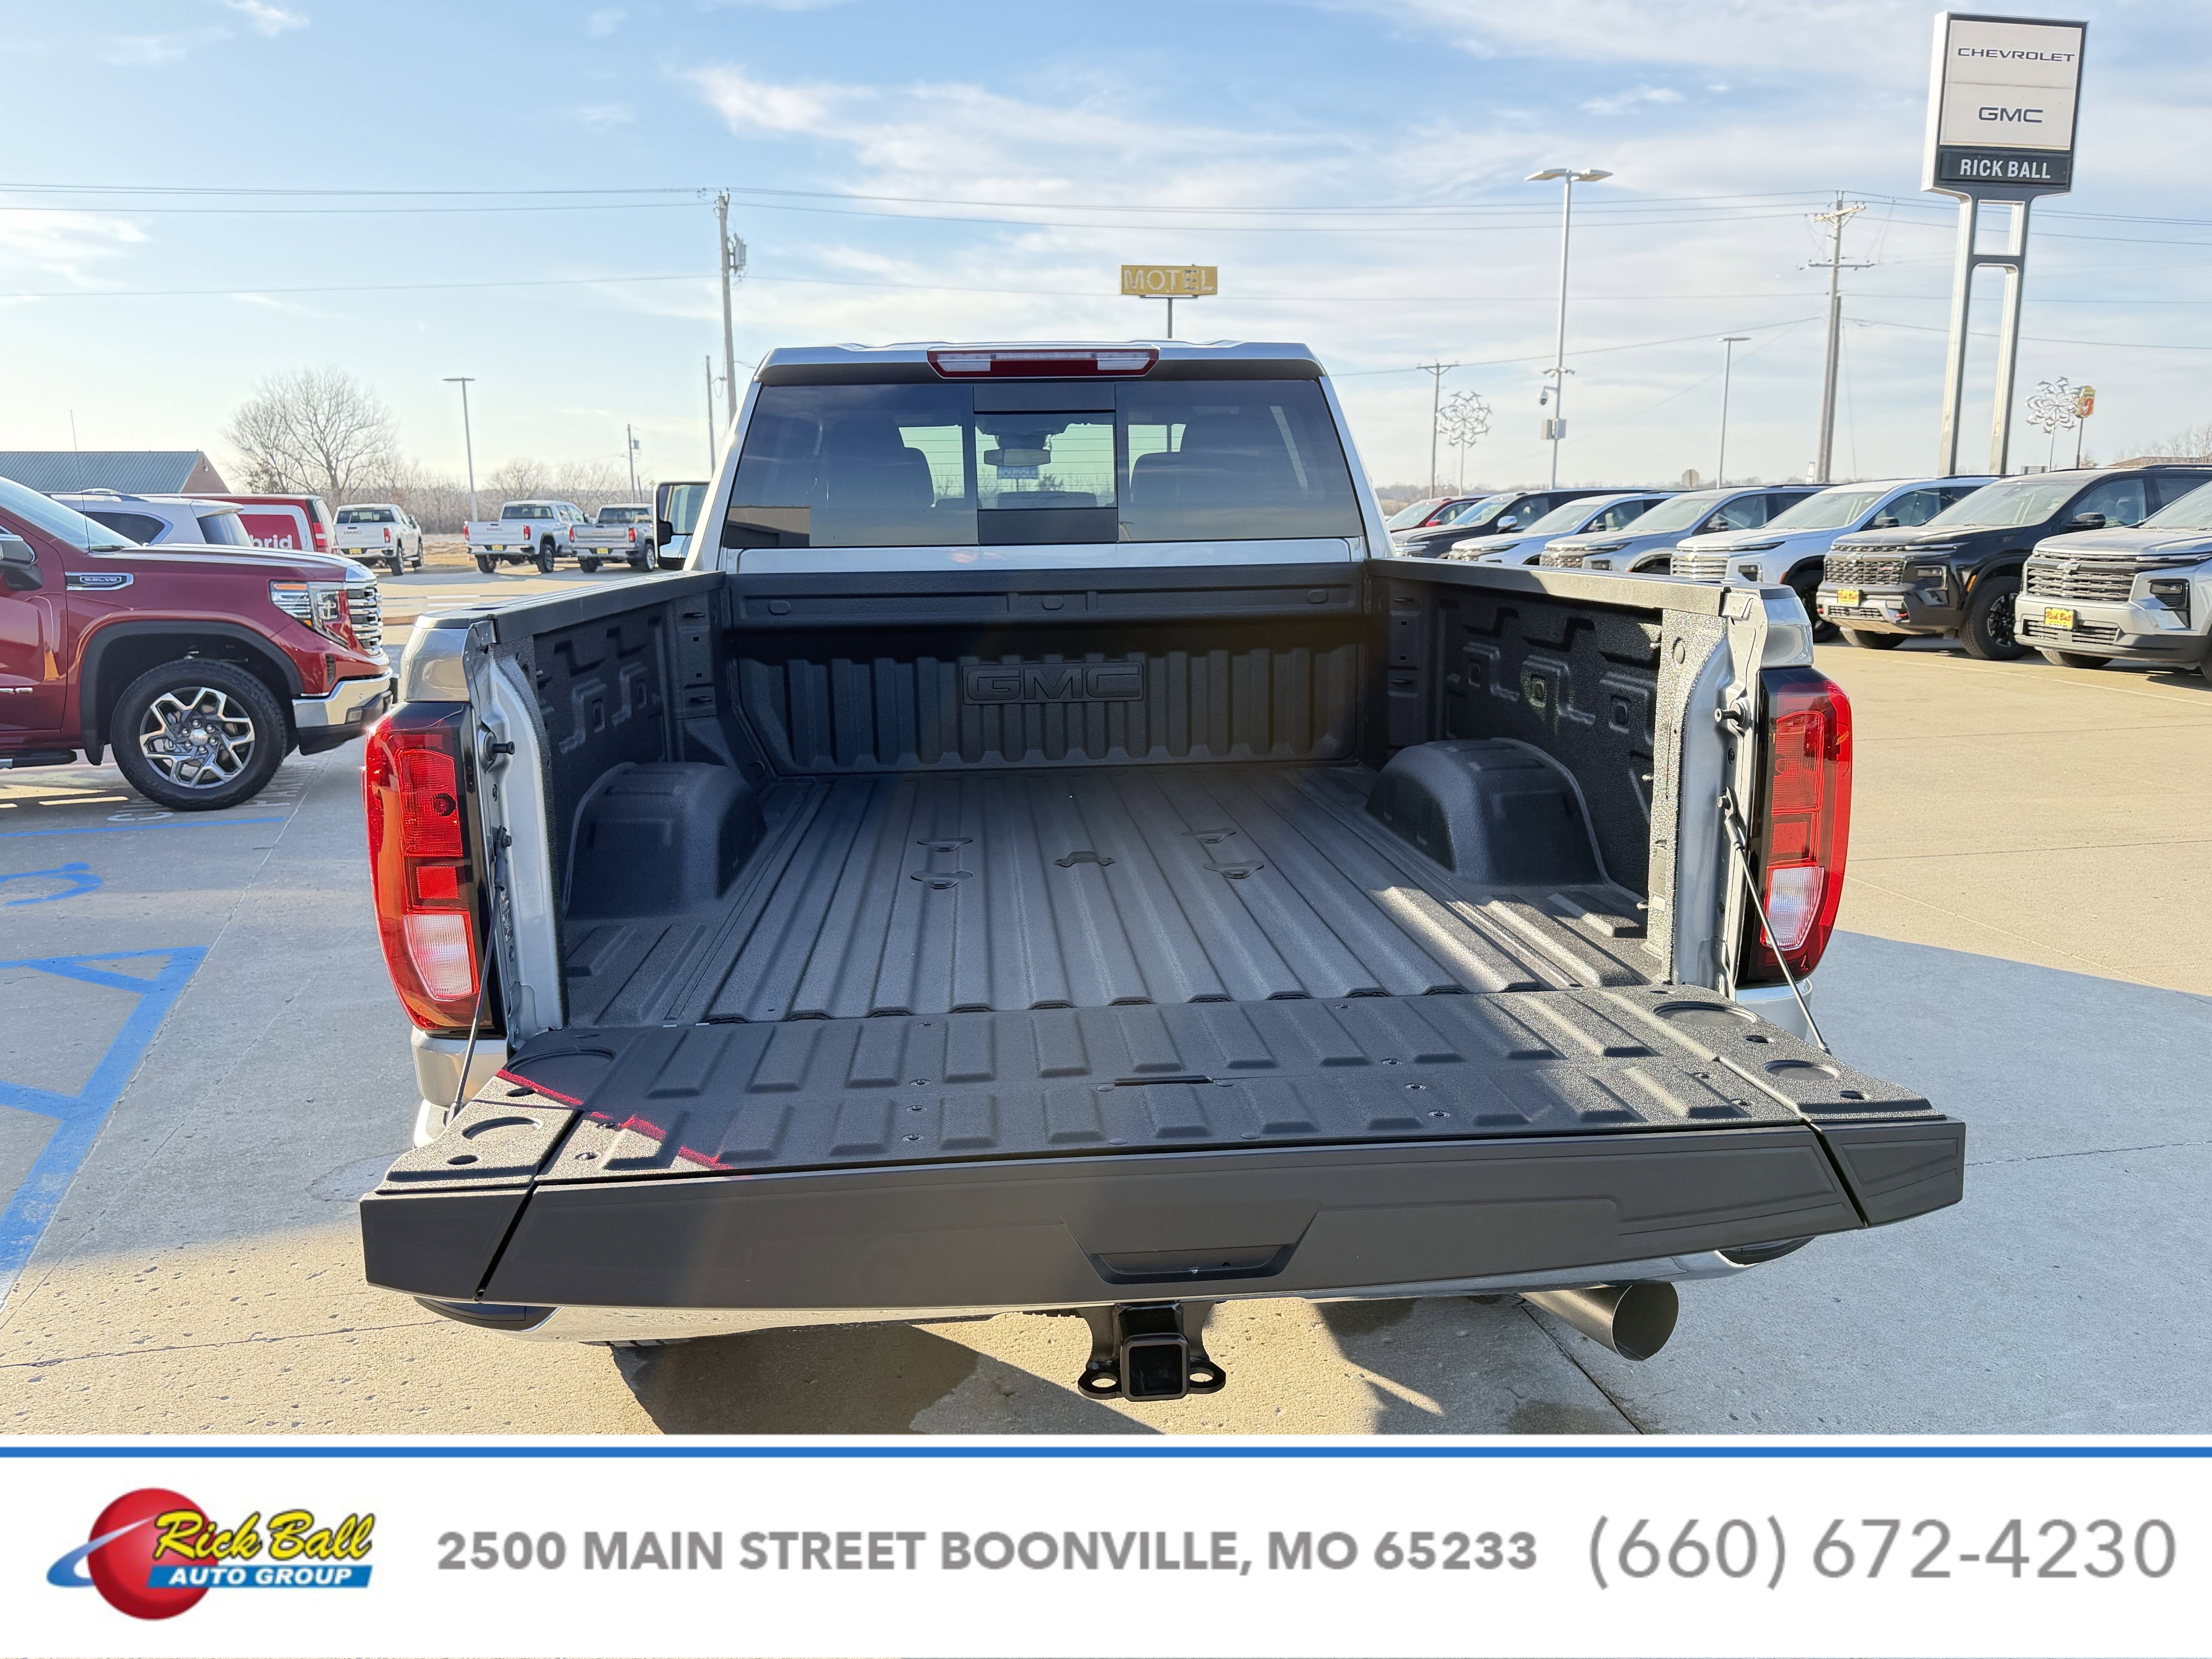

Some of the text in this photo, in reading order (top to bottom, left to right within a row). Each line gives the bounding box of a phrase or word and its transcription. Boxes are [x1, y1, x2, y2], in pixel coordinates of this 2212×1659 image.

[1958, 48, 2075, 62] CHEVROLET
[1978, 106, 2044, 124] GMC
[1960, 159, 2051, 179] RICK BALL
[1124, 269, 1214, 290] MOTEL
[967, 666, 1139, 701] GMC
